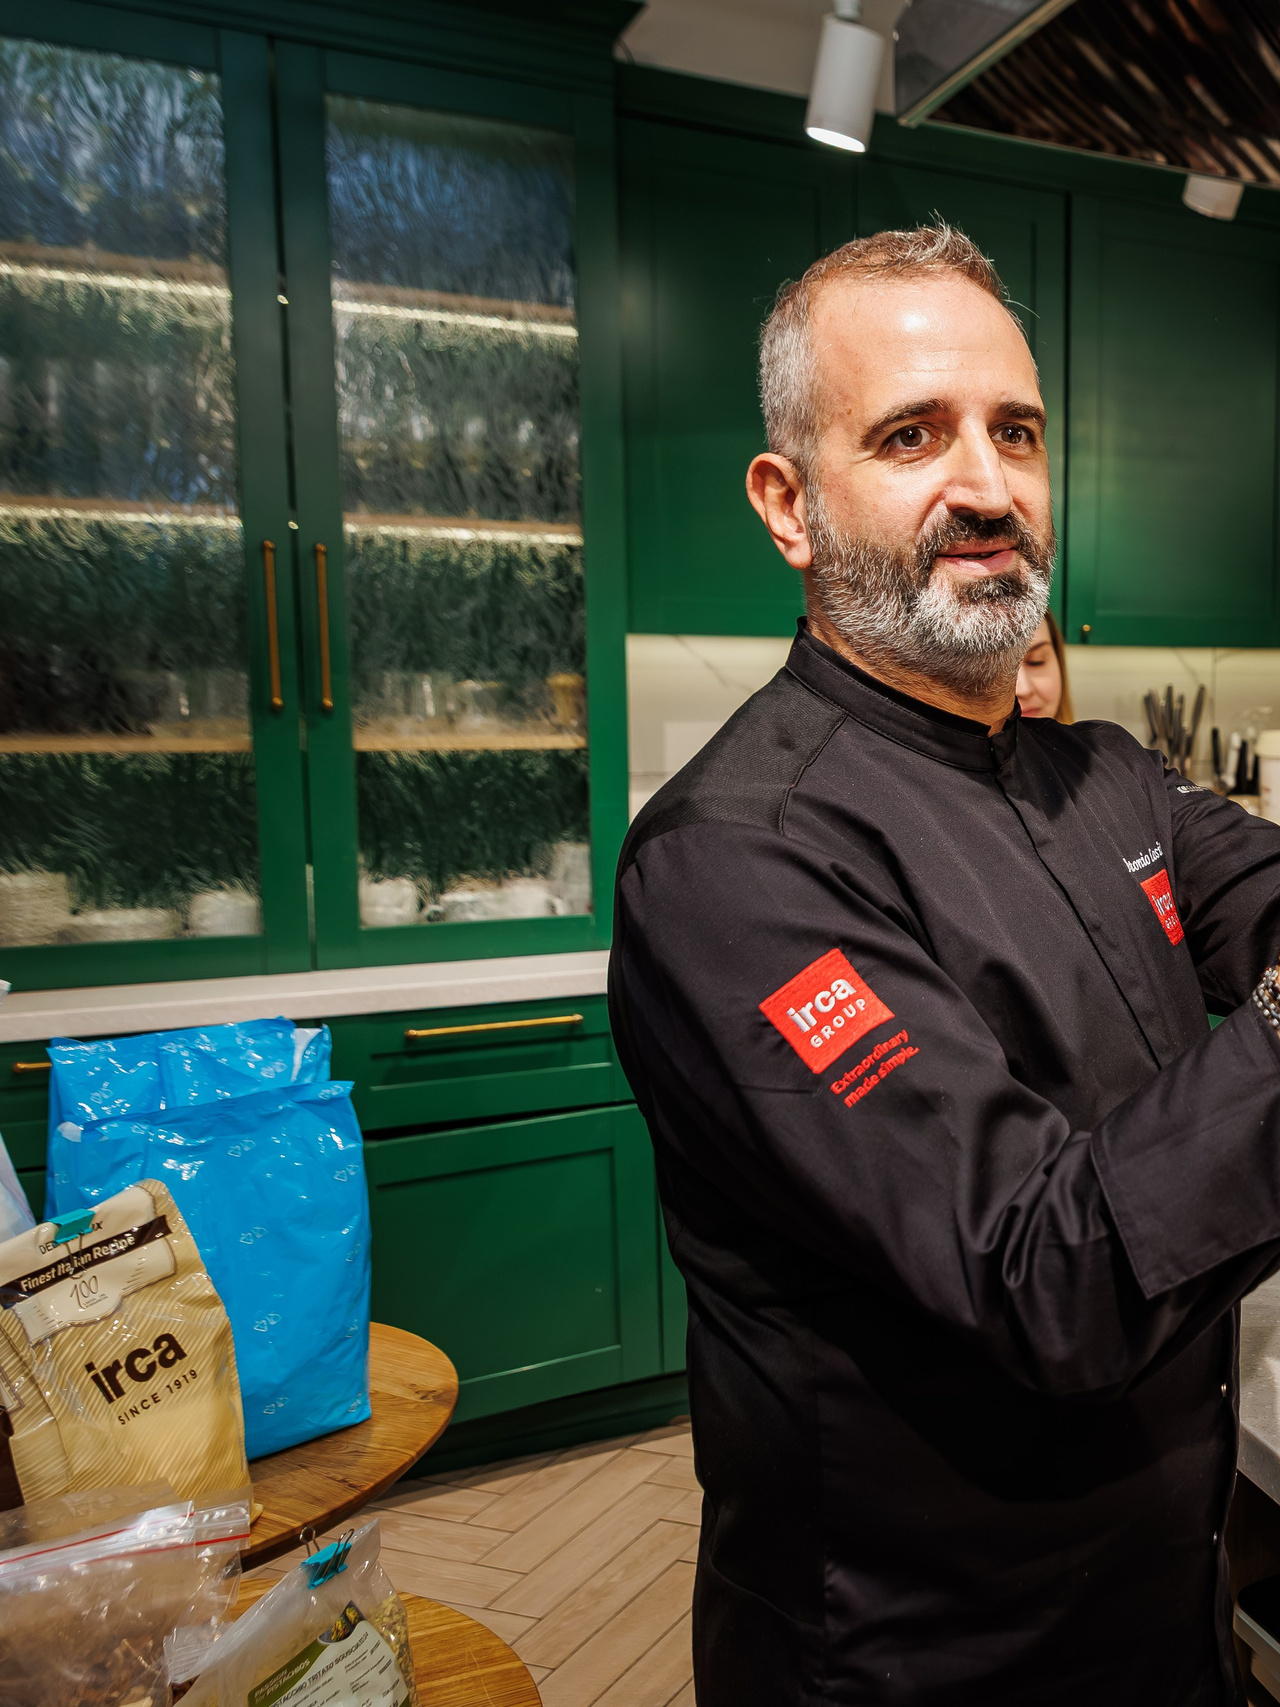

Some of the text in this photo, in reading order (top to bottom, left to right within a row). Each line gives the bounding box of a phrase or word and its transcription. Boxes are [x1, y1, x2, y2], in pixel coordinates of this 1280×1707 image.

[786, 978, 858, 1034] irca
[810, 998, 867, 1049] GROUP
[830, 1029, 910, 1096] Extraordinary
[843, 1073, 881, 1109] made
[20, 1270, 57, 1293] Finest
[92, 1233, 137, 1261] Recipe
[84, 1332, 188, 1405] irca
[117, 1369, 198, 1426] SINCE 1919
